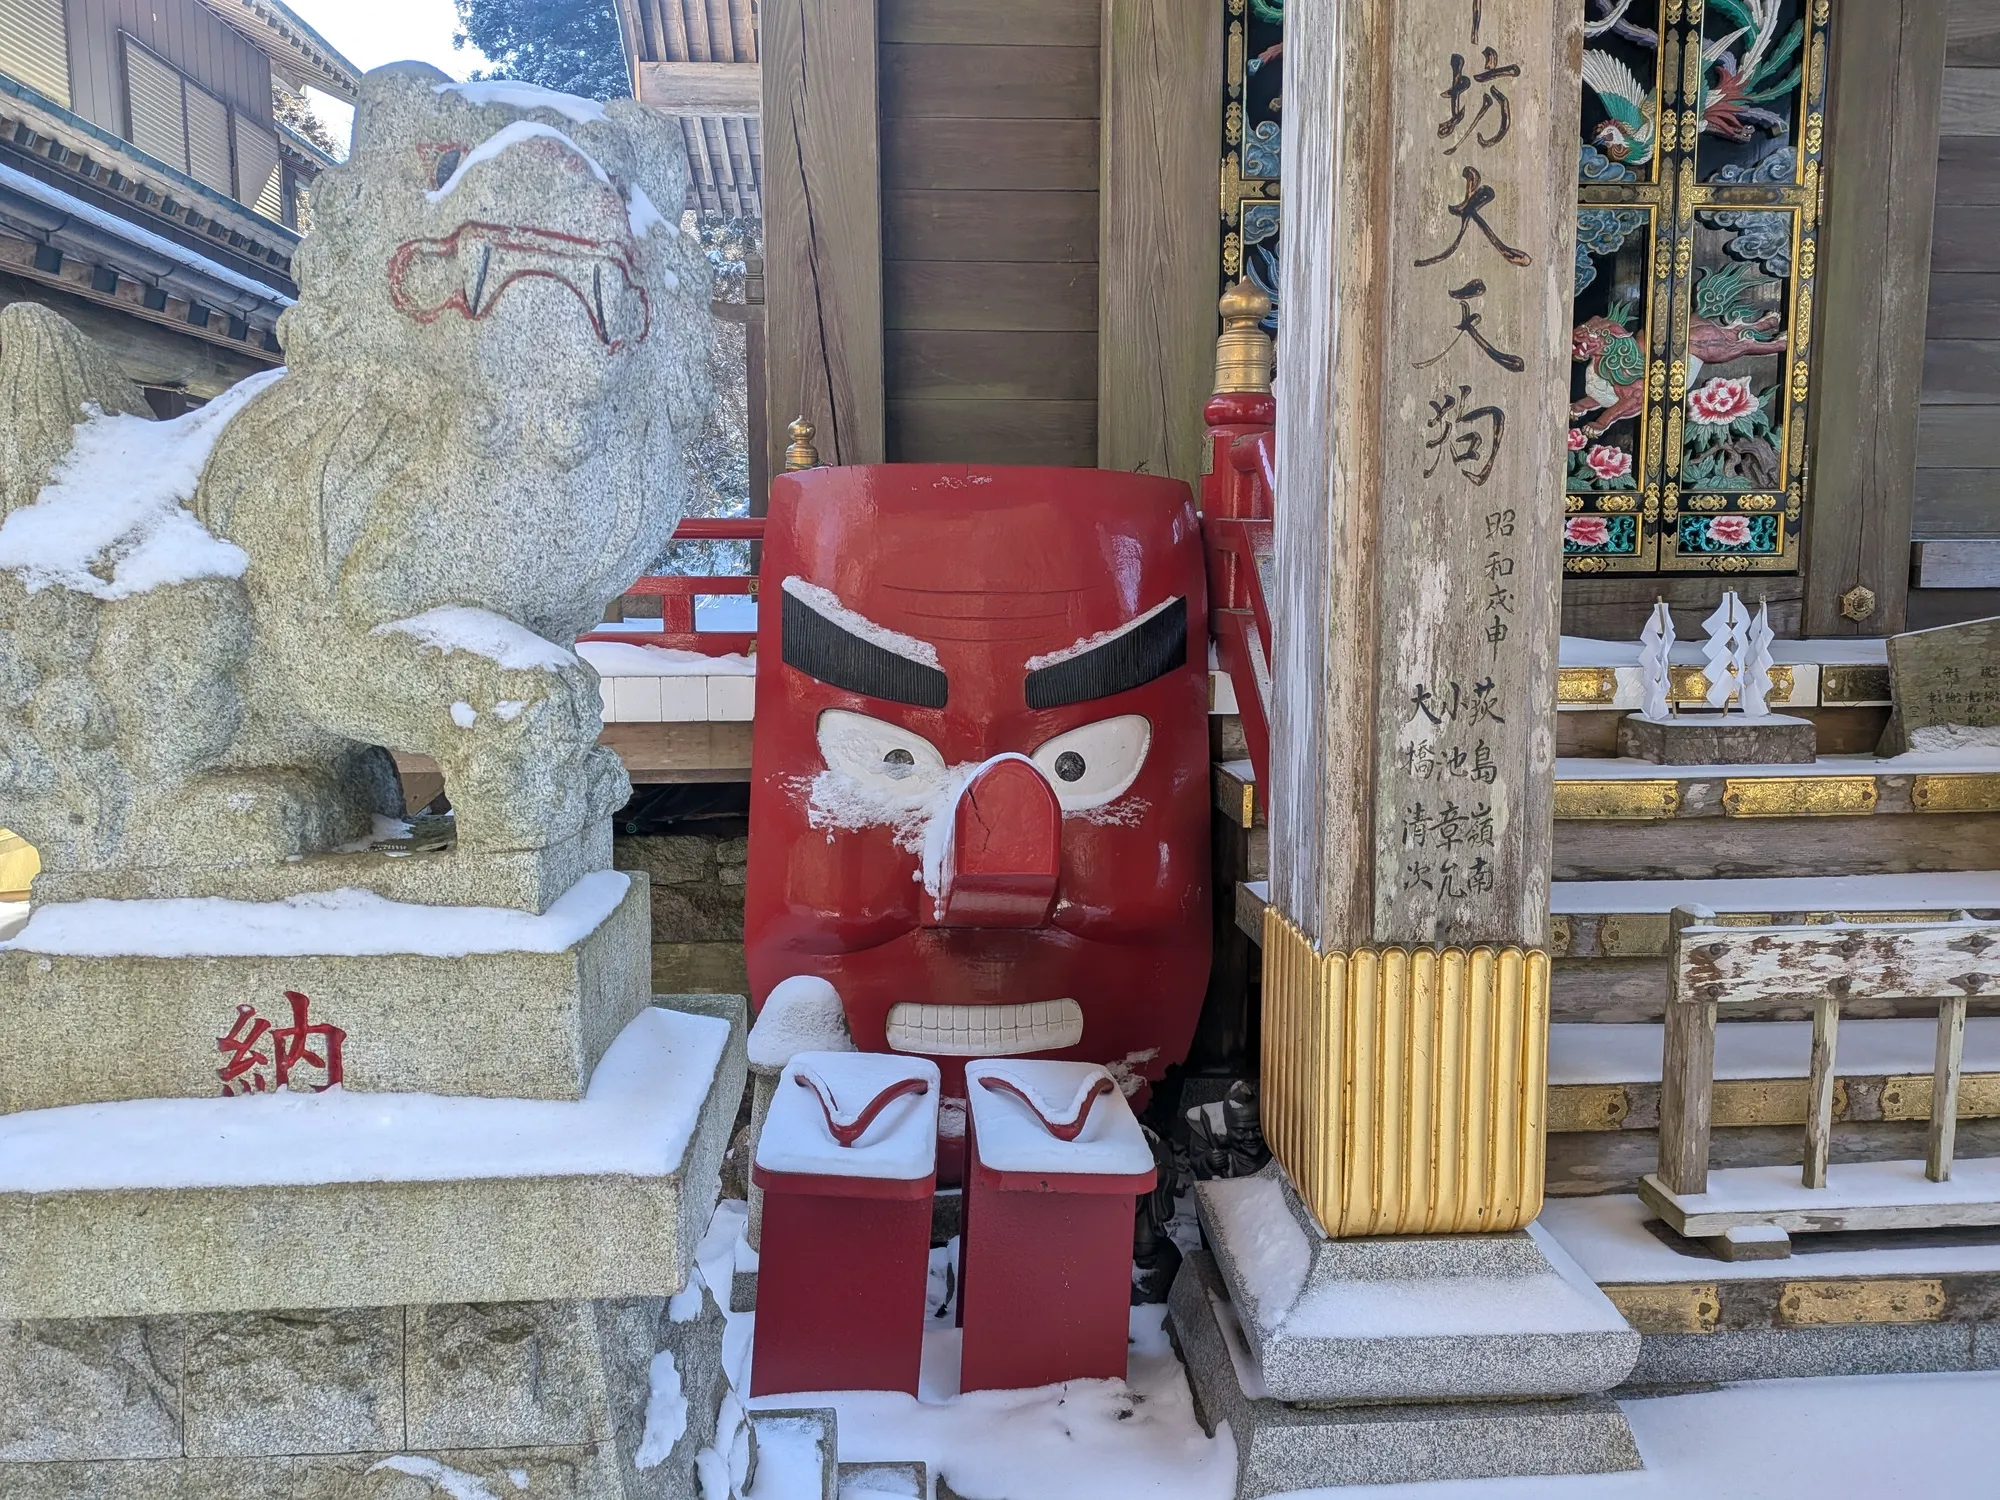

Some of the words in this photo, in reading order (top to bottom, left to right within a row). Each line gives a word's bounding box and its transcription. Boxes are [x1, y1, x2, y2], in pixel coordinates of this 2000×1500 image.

[1412, 0, 1532, 487] 坊大天狗
[216, 990, 347, 1097] 納
